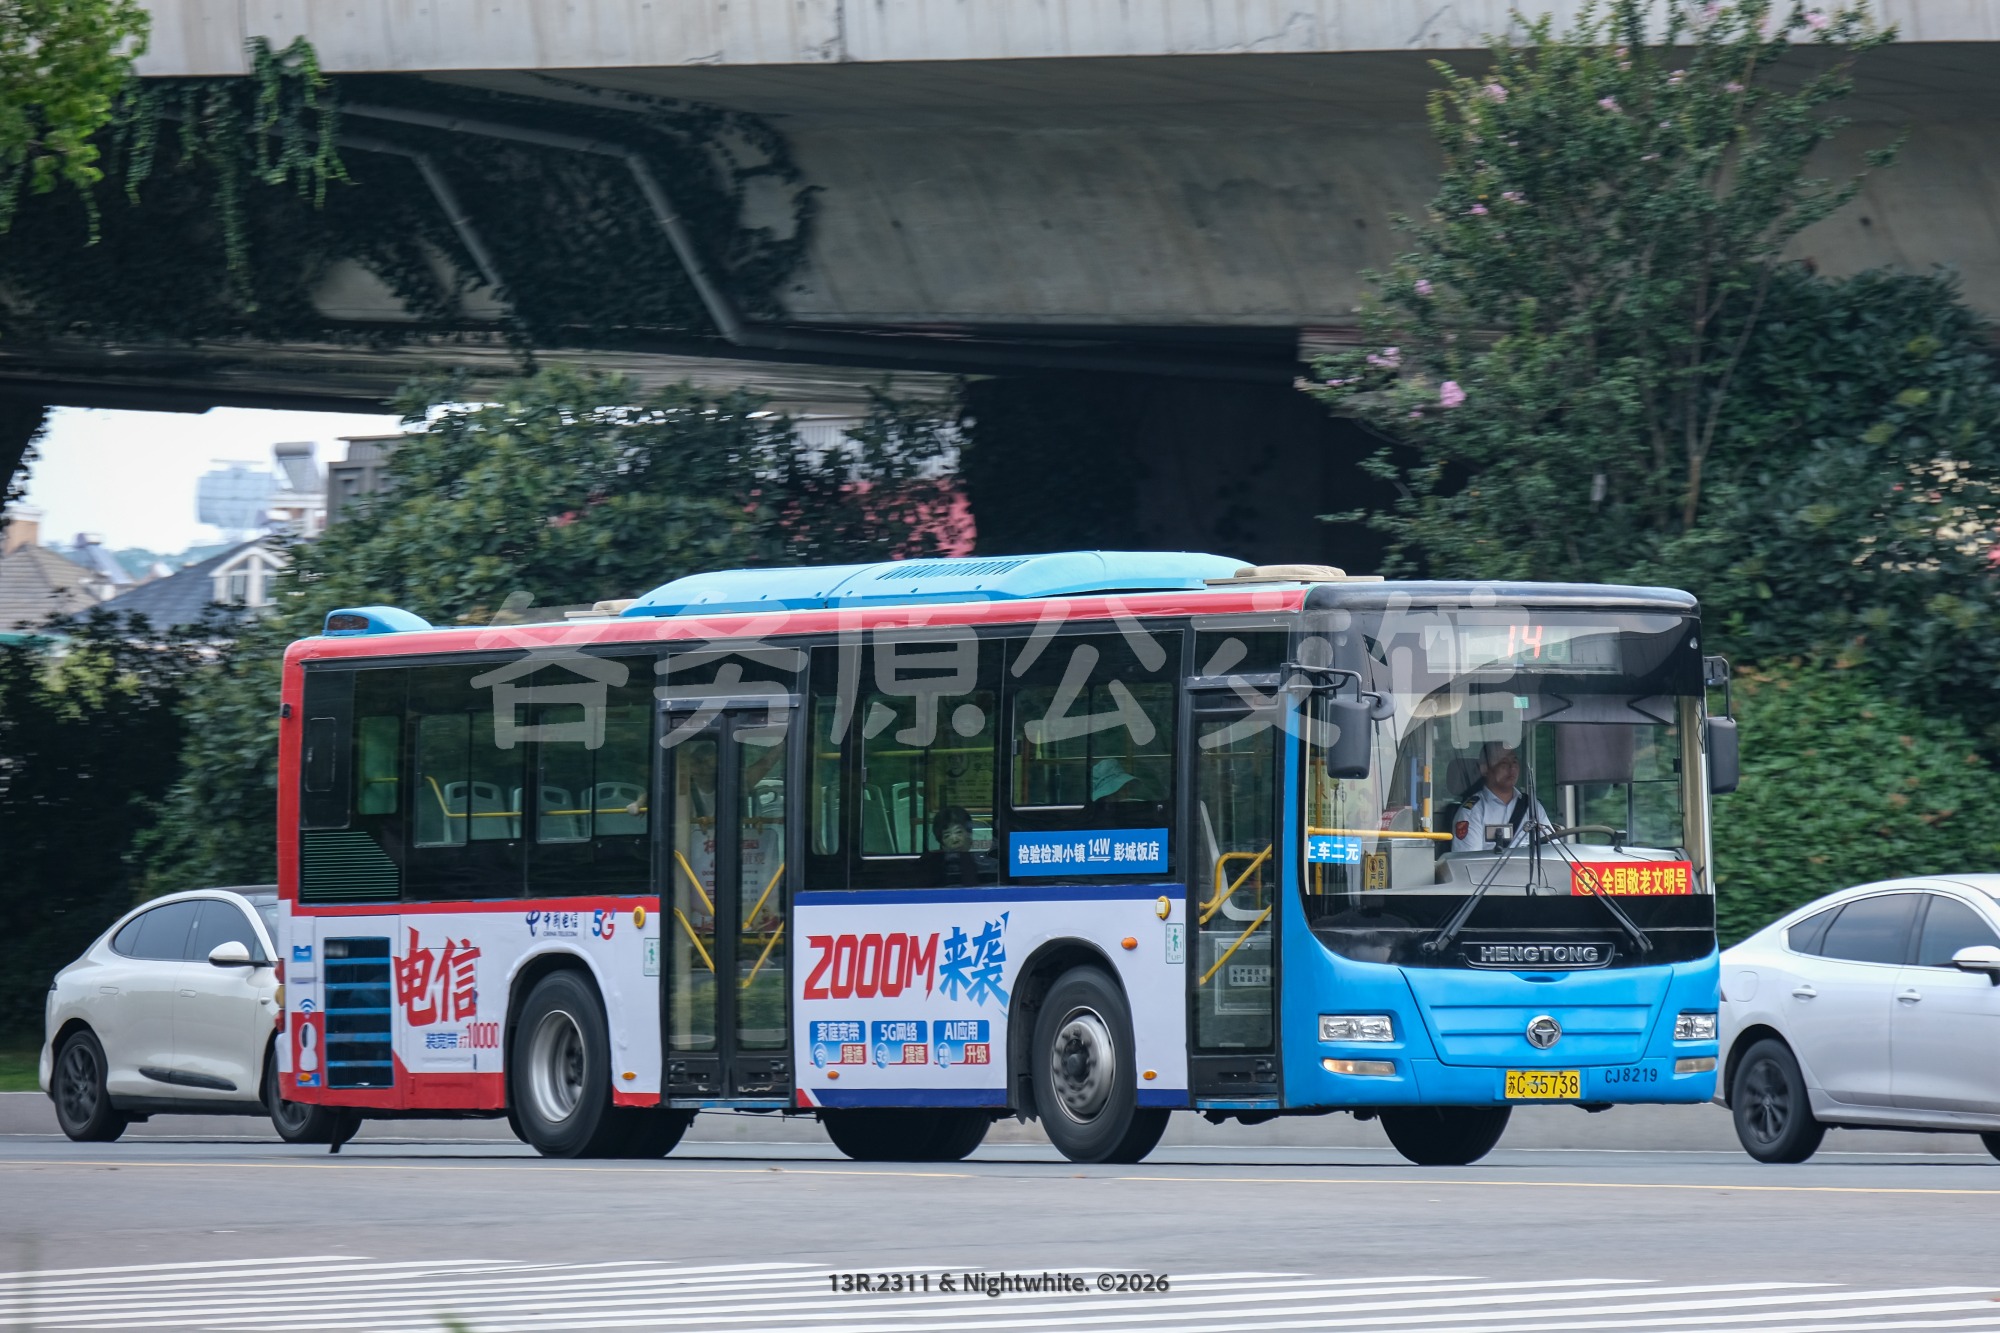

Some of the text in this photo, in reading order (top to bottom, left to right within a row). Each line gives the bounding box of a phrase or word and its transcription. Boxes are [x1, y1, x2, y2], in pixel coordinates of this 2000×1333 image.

[1507, 625, 1543, 659] 14
[1018, 843, 1086, 865] 检验检测小镇
[1088, 838, 1111, 856] 14W
[1113, 841, 1160, 862] 彭城饭店
[1307, 841, 1359, 861] 上车二元
[1601, 868, 1688, 895] 全国敬老文明号
[592, 908, 617, 941] 5G
[1480, 946, 1599, 962] HENGTONG
[392, 926, 482, 1028] 电信
[817, 1022, 861, 1042] 家庭宽带
[880, 1022, 918, 1042] 5G网络
[943, 1021, 979, 1041] AI应用
[842, 1045, 864, 1064] 提速
[904, 1045, 926, 1064] 提速
[966, 1045, 988, 1064] 升级
[1605, 1068, 1658, 1084] CJ8219
